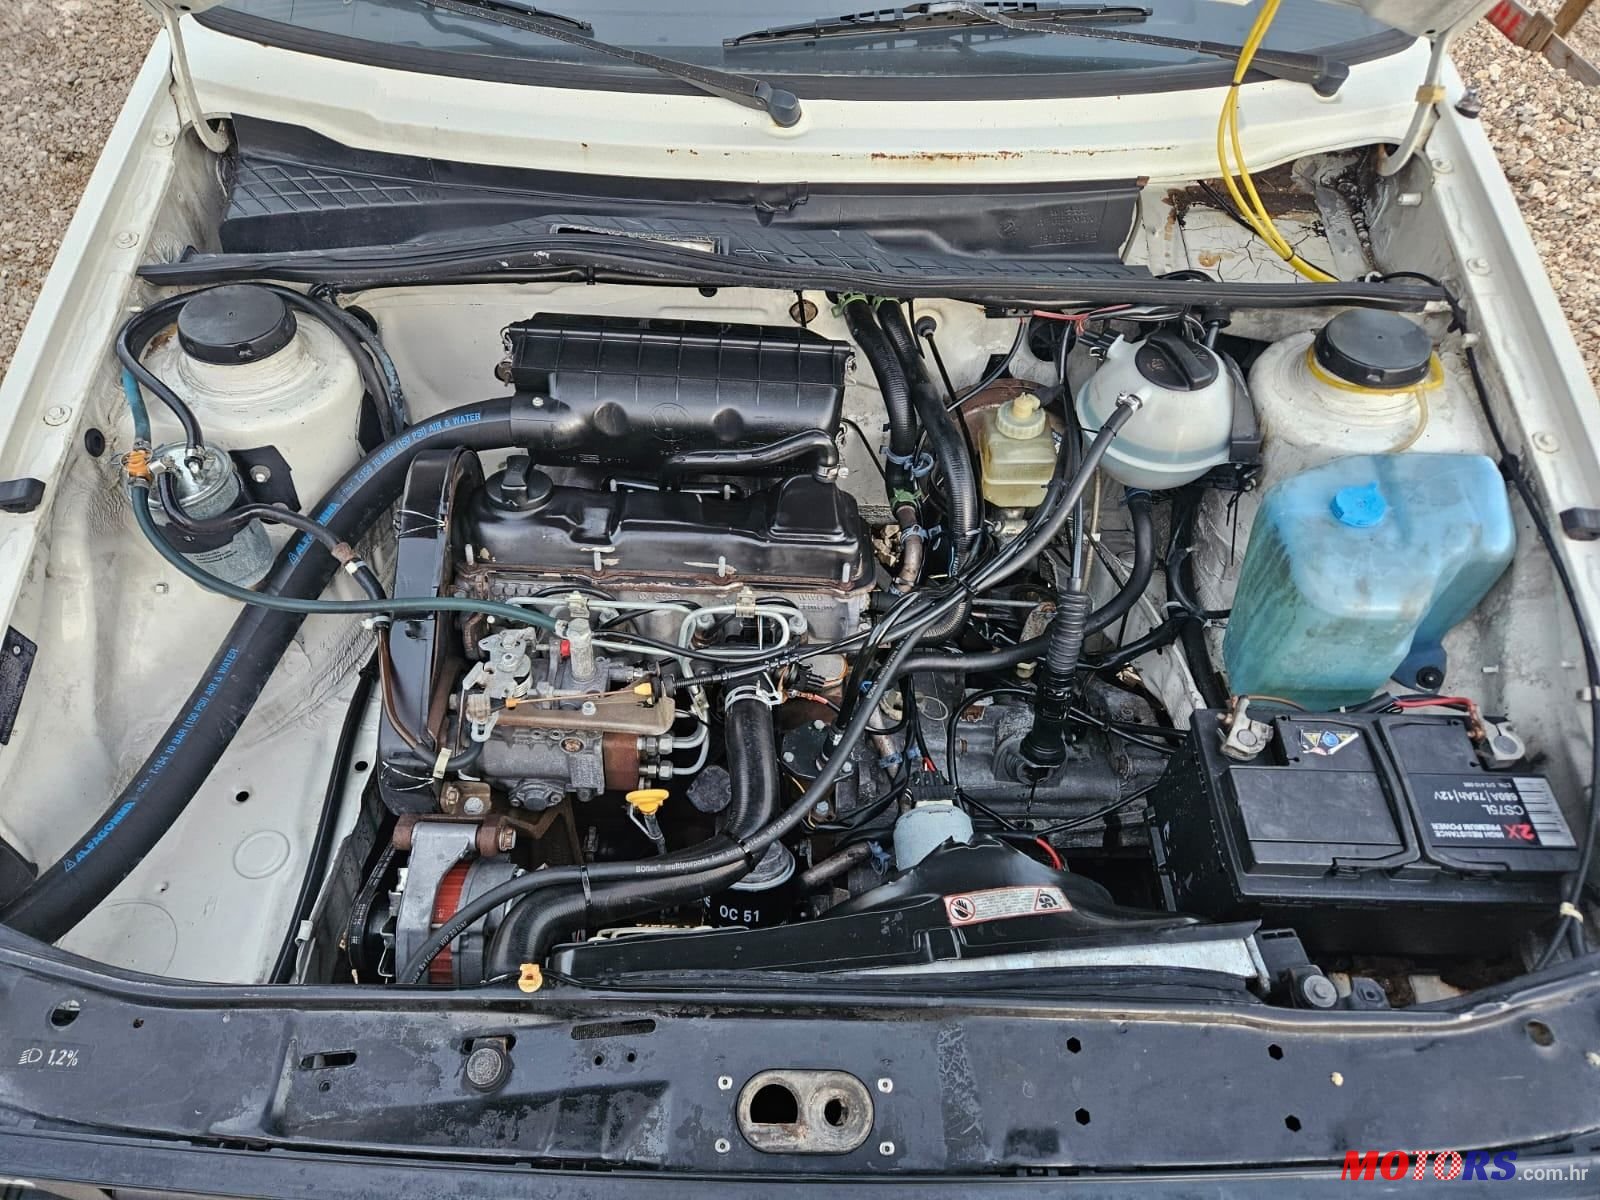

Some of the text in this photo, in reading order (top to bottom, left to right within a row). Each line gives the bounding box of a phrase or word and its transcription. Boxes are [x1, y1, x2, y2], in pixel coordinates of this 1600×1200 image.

[381, 446, 396, 461] BAR
[428, 421, 443, 433] AIR
[453, 412, 481, 426] WATER
[166, 745, 177, 755] 10
[172, 728, 189, 745] BAR
[205, 682, 219, 697] AIR
[217, 648, 239, 675] WATER
[1481, 804, 1524, 816] CS75L
[1431, 822, 1462, 831] POWER
[1504, 823, 1535, 840] 2X
[719, 905, 760, 922] OC 51
